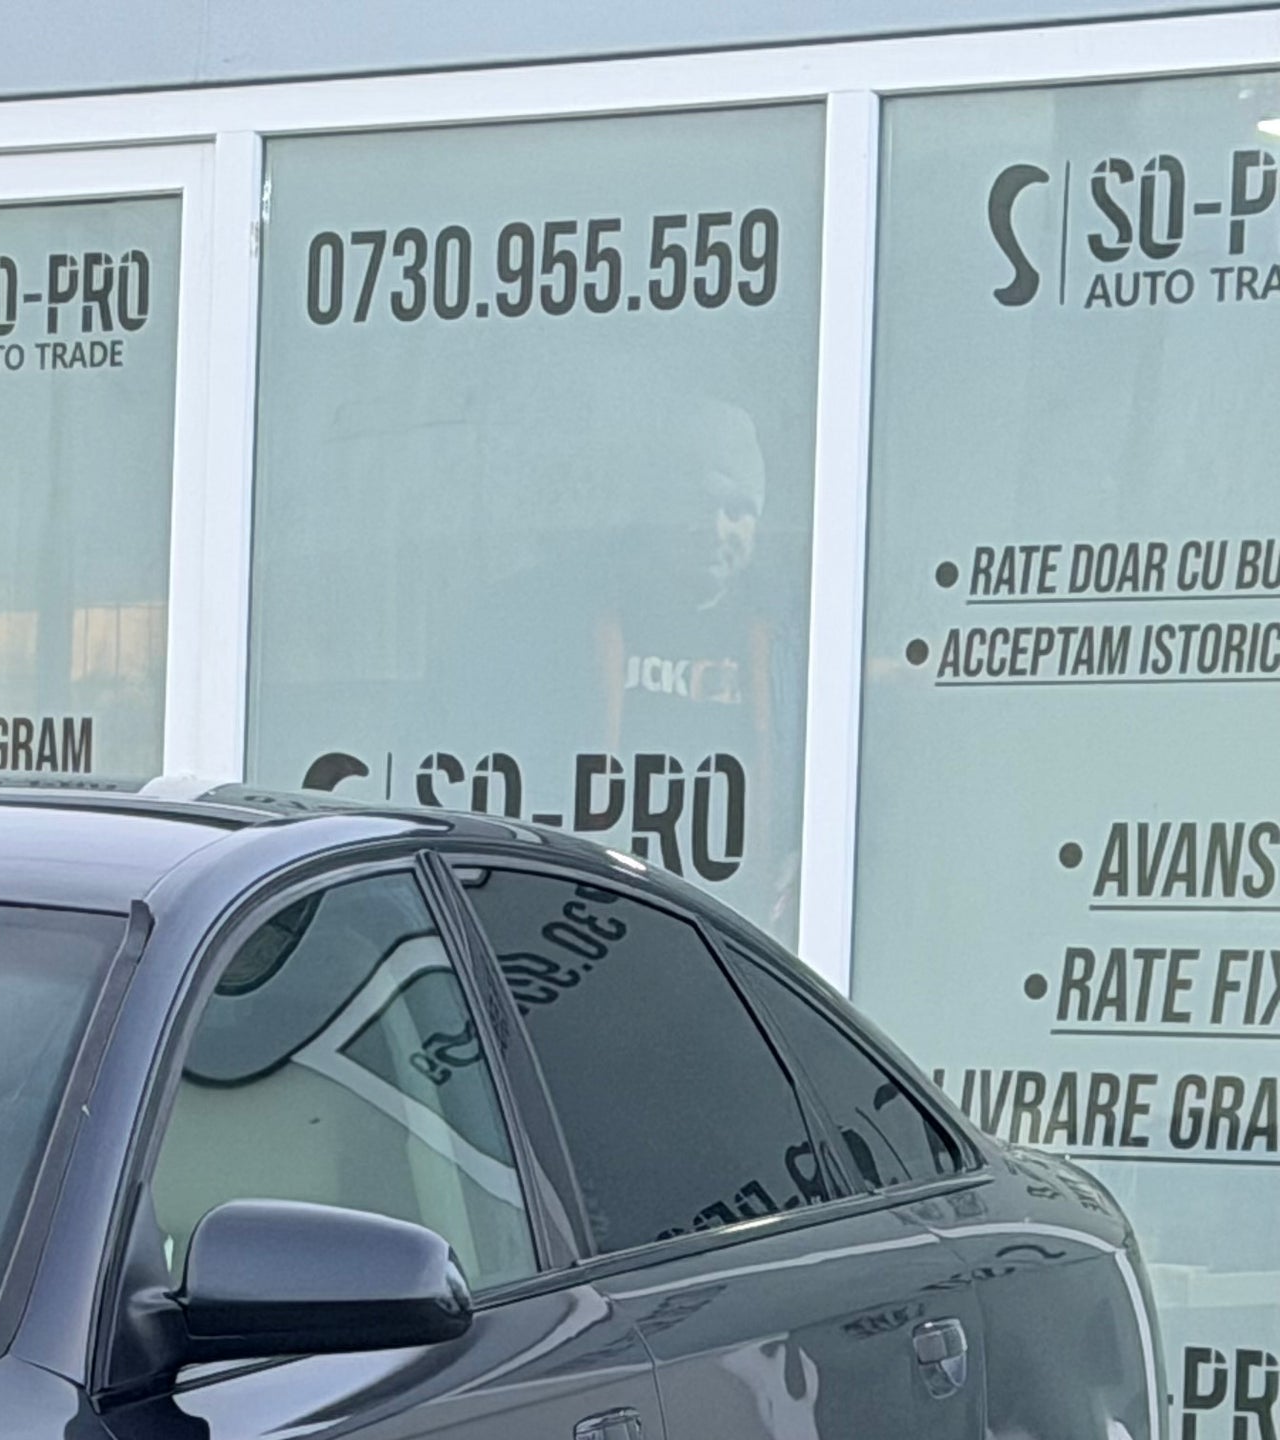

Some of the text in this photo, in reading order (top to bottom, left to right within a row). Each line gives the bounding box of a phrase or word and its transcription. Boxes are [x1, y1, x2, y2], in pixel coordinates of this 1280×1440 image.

[306, 207, 780, 326] 0730.955.559
[1083, 268, 1195, 309] AUTO
[35, 339, 124, 371] TRADE
[969, 544, 1062, 596] RATE
[1068, 541, 1169, 594] DOAR
[1177, 539, 1228, 592] CU
[936, 624, 1132, 679] ACCEPTAM
[1092, 821, 1280, 899] AVANS
[1056, 946, 1201, 1024] RATE
[933, 1068, 1159, 1149] IVRARE
